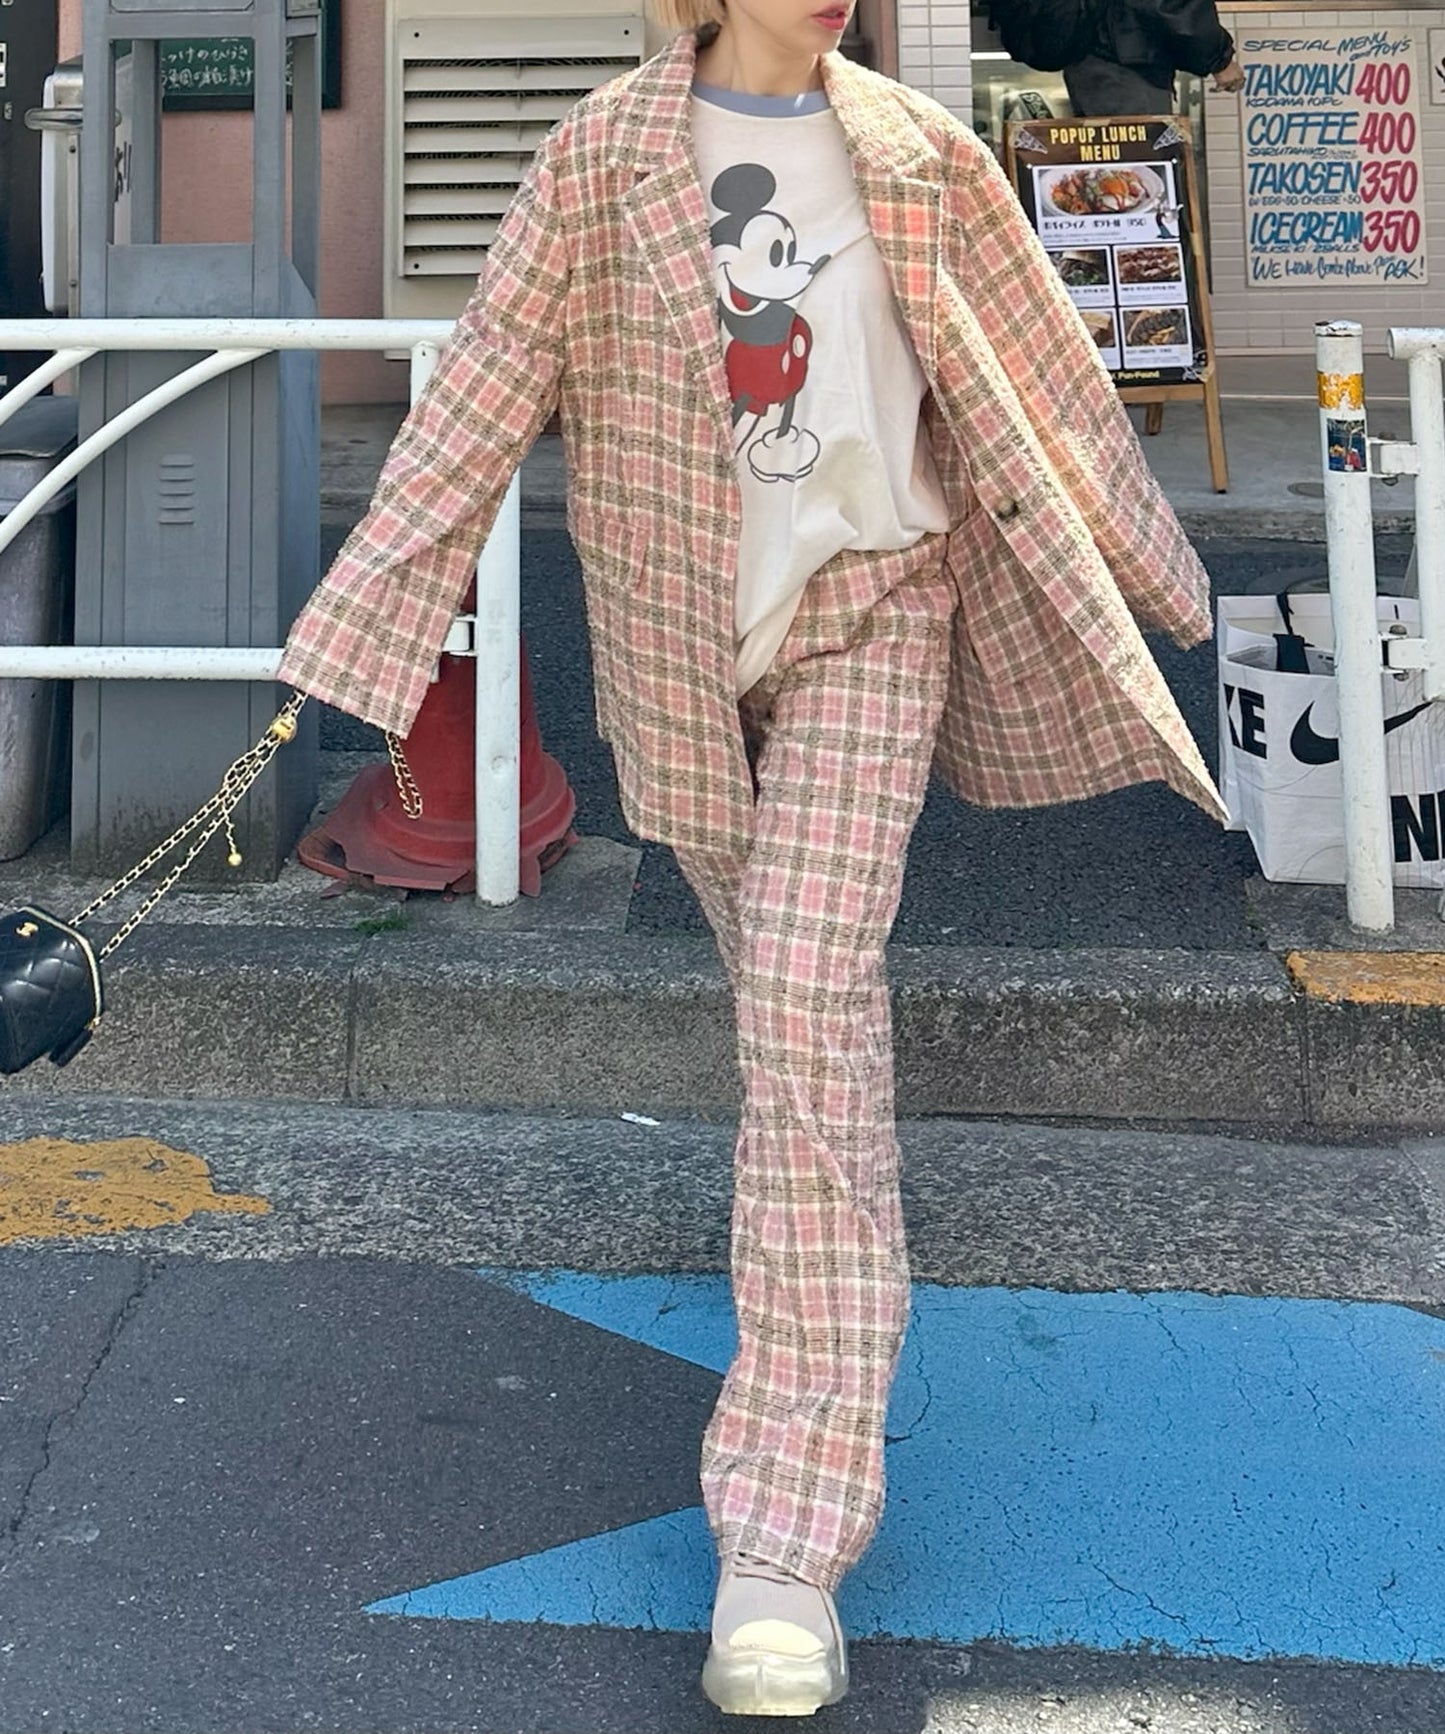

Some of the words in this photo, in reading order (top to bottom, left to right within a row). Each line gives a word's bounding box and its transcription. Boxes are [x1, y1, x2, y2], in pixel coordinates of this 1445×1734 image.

[1243, 38, 1336, 52] SPECIAL
[1337, 31, 1388, 55] MENU
[1243, 63, 1355, 97] TAKOYAKI
[1355, 62, 1411, 105] 400
[1050, 126, 1096, 144] POPUP
[1101, 125, 1147, 143] LUNCH
[1080, 144, 1121, 162] MENU
[1247, 111, 1359, 146] COFFEE
[1359, 112, 1416, 154] 400
[1247, 160, 1363, 195] TAKOSEN
[1360, 160, 1418, 204] 350
[1250, 211, 1364, 245] ICECREAM
[1362, 210, 1420, 253] 350
